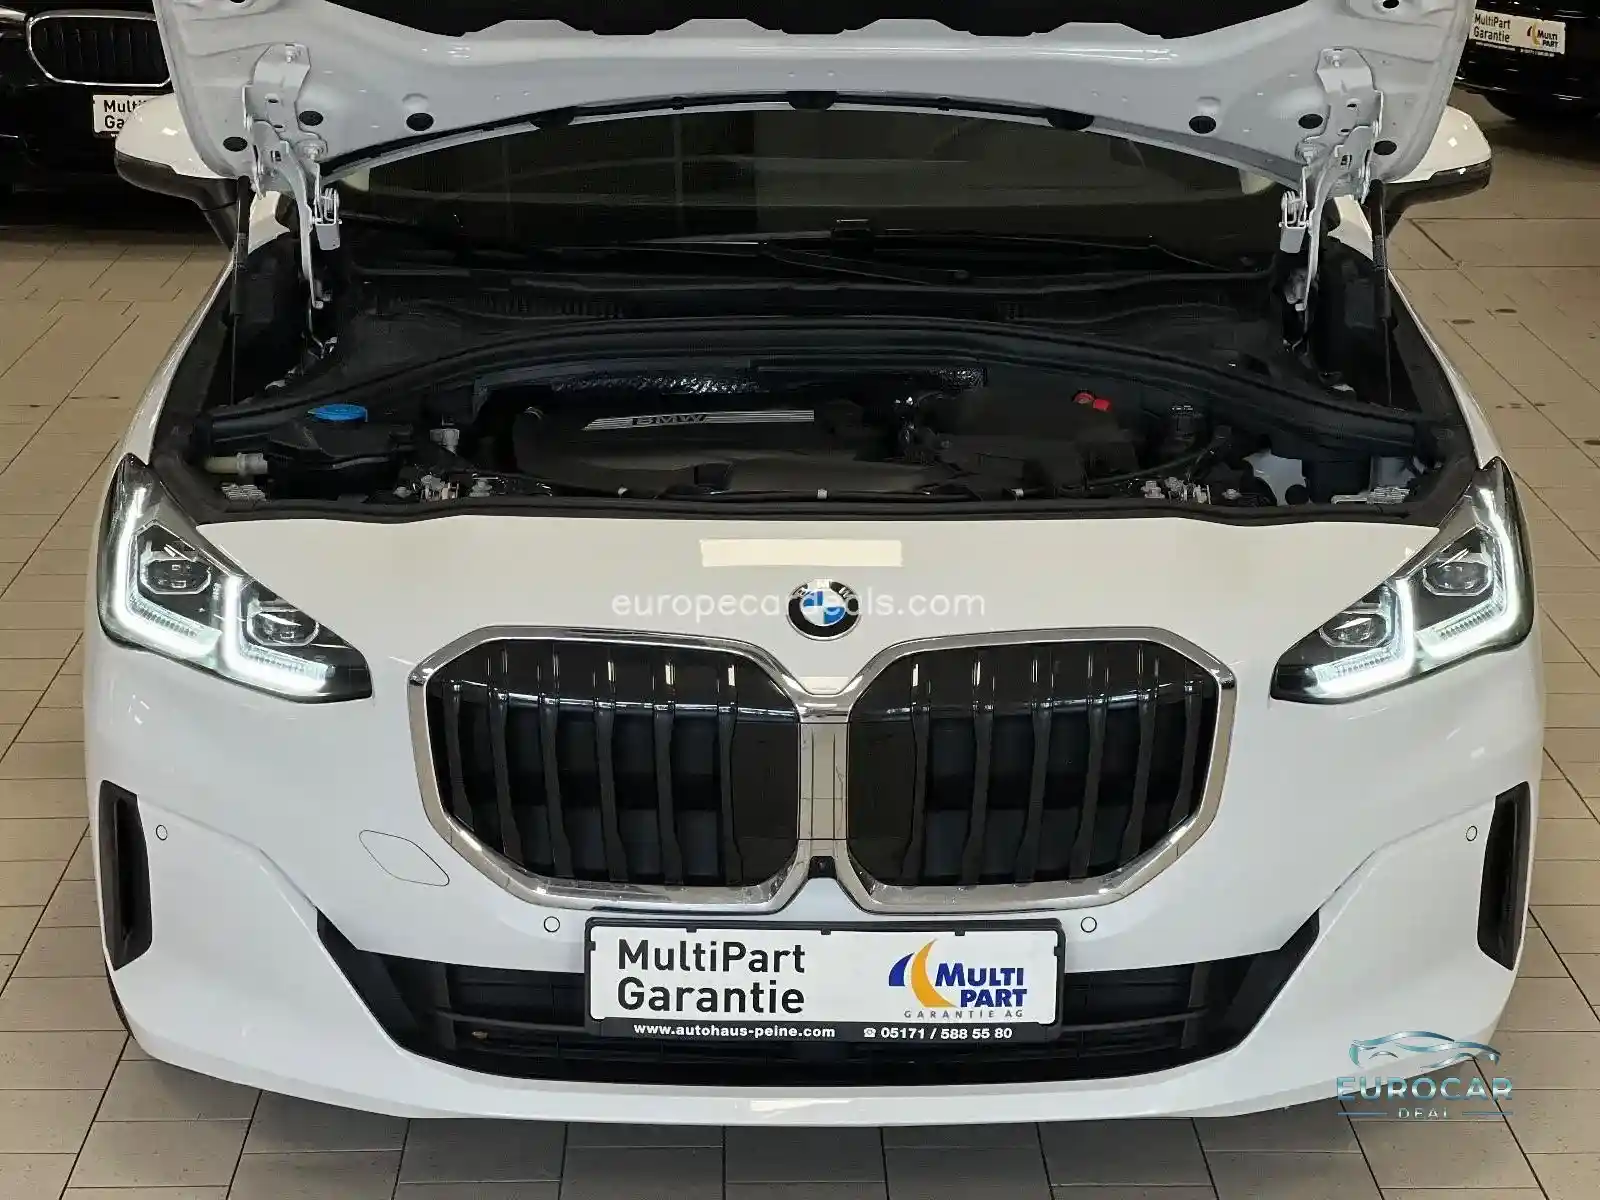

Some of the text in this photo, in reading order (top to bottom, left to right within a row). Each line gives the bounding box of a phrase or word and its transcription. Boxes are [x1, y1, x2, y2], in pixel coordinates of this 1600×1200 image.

[1474, 13, 1511, 30] MultiPart
[1473, 26, 1510, 43] Garantie
[104, 115, 125, 129] Ga
[631, 414, 708, 425] BMW
[618, 938, 806, 974] MultiPart
[617, 976, 805, 1014] Garantie
[960, 988, 1028, 1008] PART
[903, 1009, 1024, 1019] GARANTIE AG
[633, 1023, 836, 1038] www.autohaus-peine.com
[880, 1027, 1013, 1040] 05171 / 588 55 80
